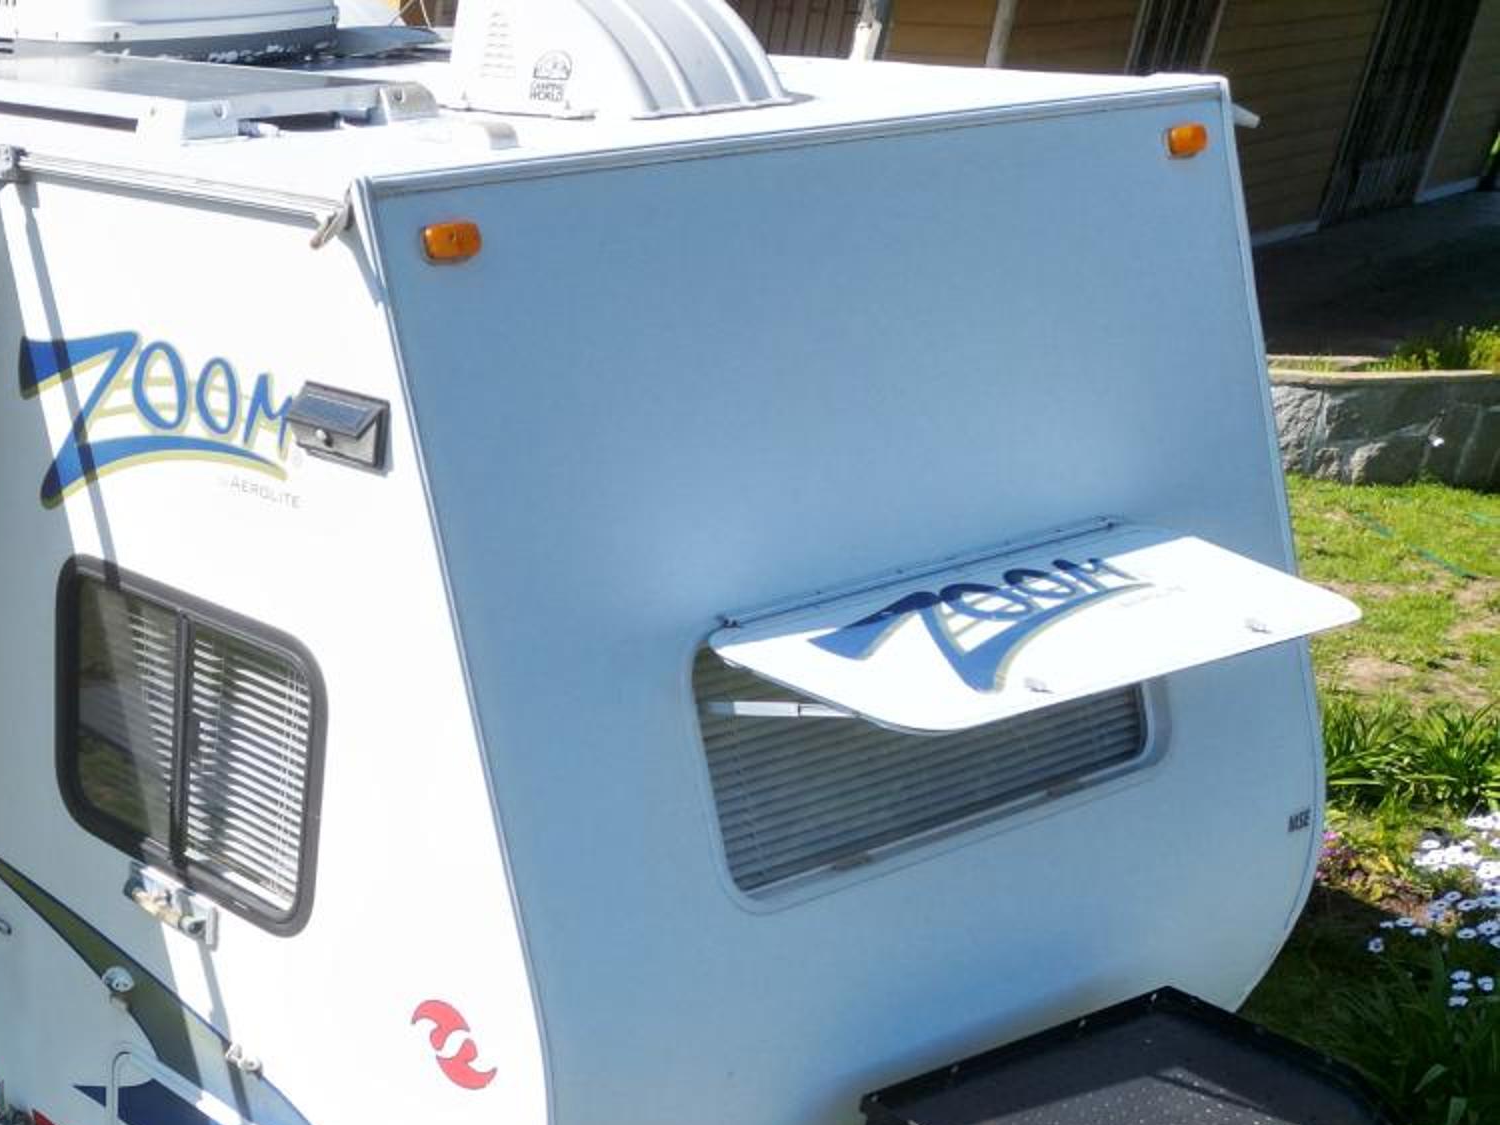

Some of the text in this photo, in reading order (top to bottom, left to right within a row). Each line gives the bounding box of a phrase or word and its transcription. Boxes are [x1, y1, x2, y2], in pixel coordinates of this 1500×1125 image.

[529, 89, 564, 103] WORLD
[19, 330, 293, 509] ZOOM
[229, 475, 302, 509] AEROLITE
[807, 556, 1155, 693] ZOOM
